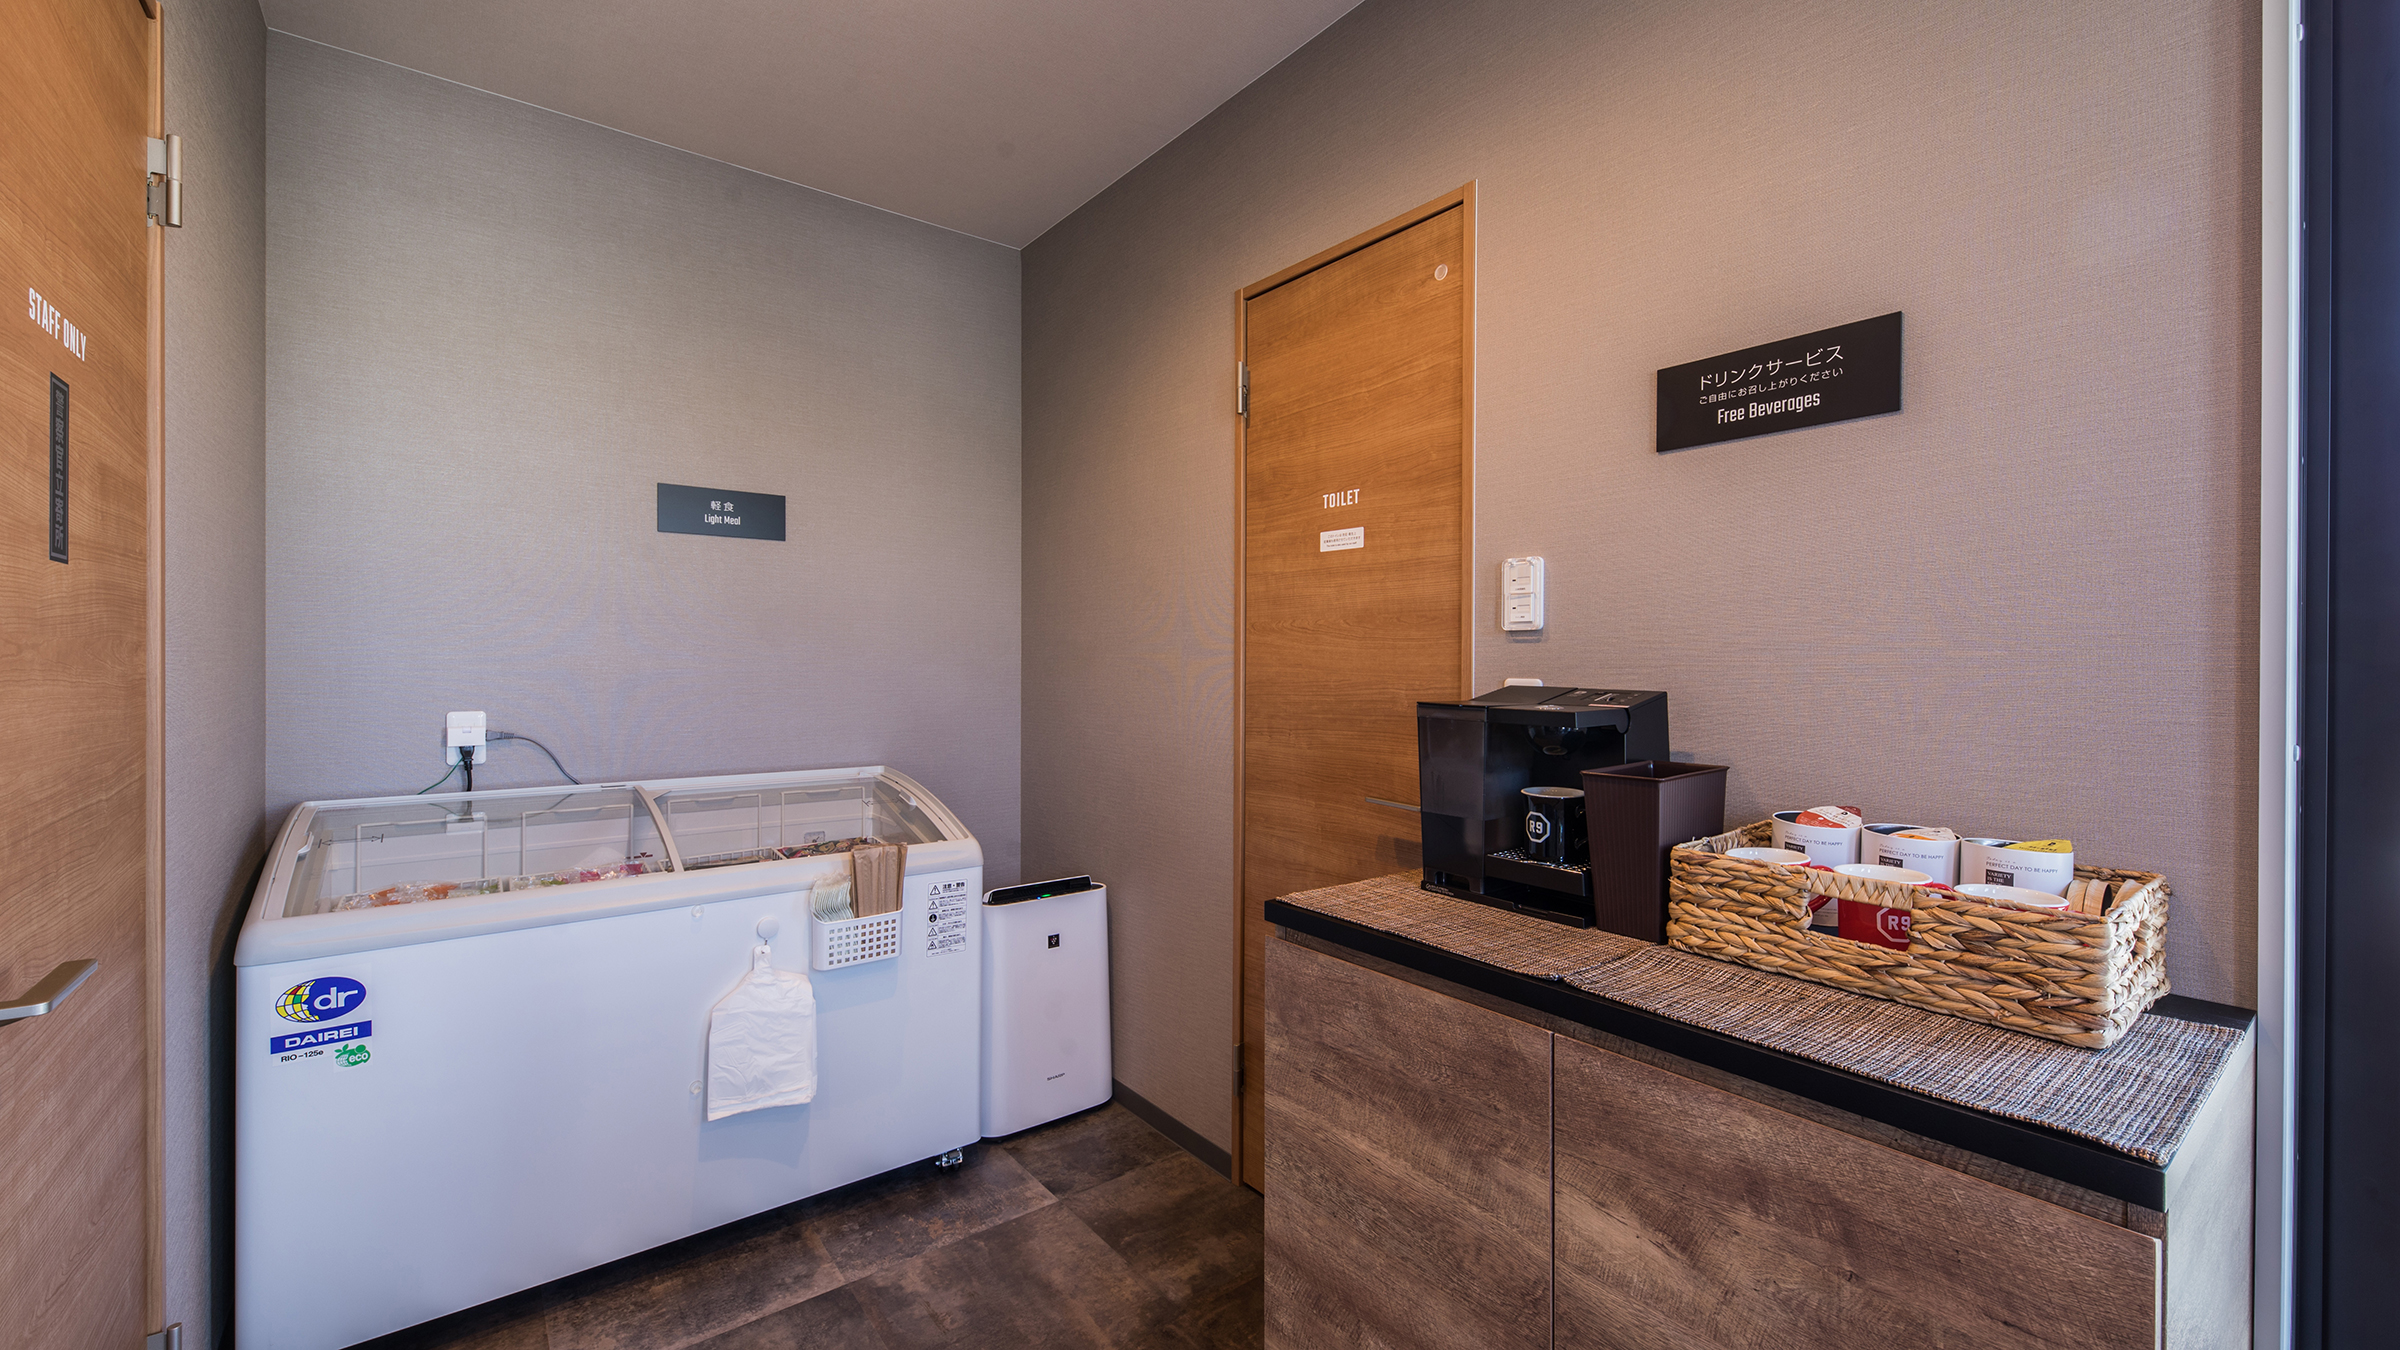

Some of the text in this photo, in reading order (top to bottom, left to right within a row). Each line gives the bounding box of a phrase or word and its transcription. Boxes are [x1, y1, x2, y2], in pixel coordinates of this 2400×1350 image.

[29, 287, 87, 362] STAFF ONLY
[1700, 345, 1844, 391] ドリンクサービス
[1699, 367, 1844, 405] ご自由にお召し上がりください
[1717, 393, 1821, 424] Free Beverages
[1322, 488, 1360, 509] TOILET
[704, 513, 741, 526] Light Meal
[1529, 819, 1543, 834] R9
[1879, 848, 1899, 856] PERFECT
[1986, 861, 2009, 869] PERFECT
[1987, 871, 2012, 879] VARIETY
[1887, 915, 1911, 931] R9
[313, 986, 359, 1010] dr
[284, 1026, 359, 1049] DAIREI
[348, 1052, 369, 1063] eco
